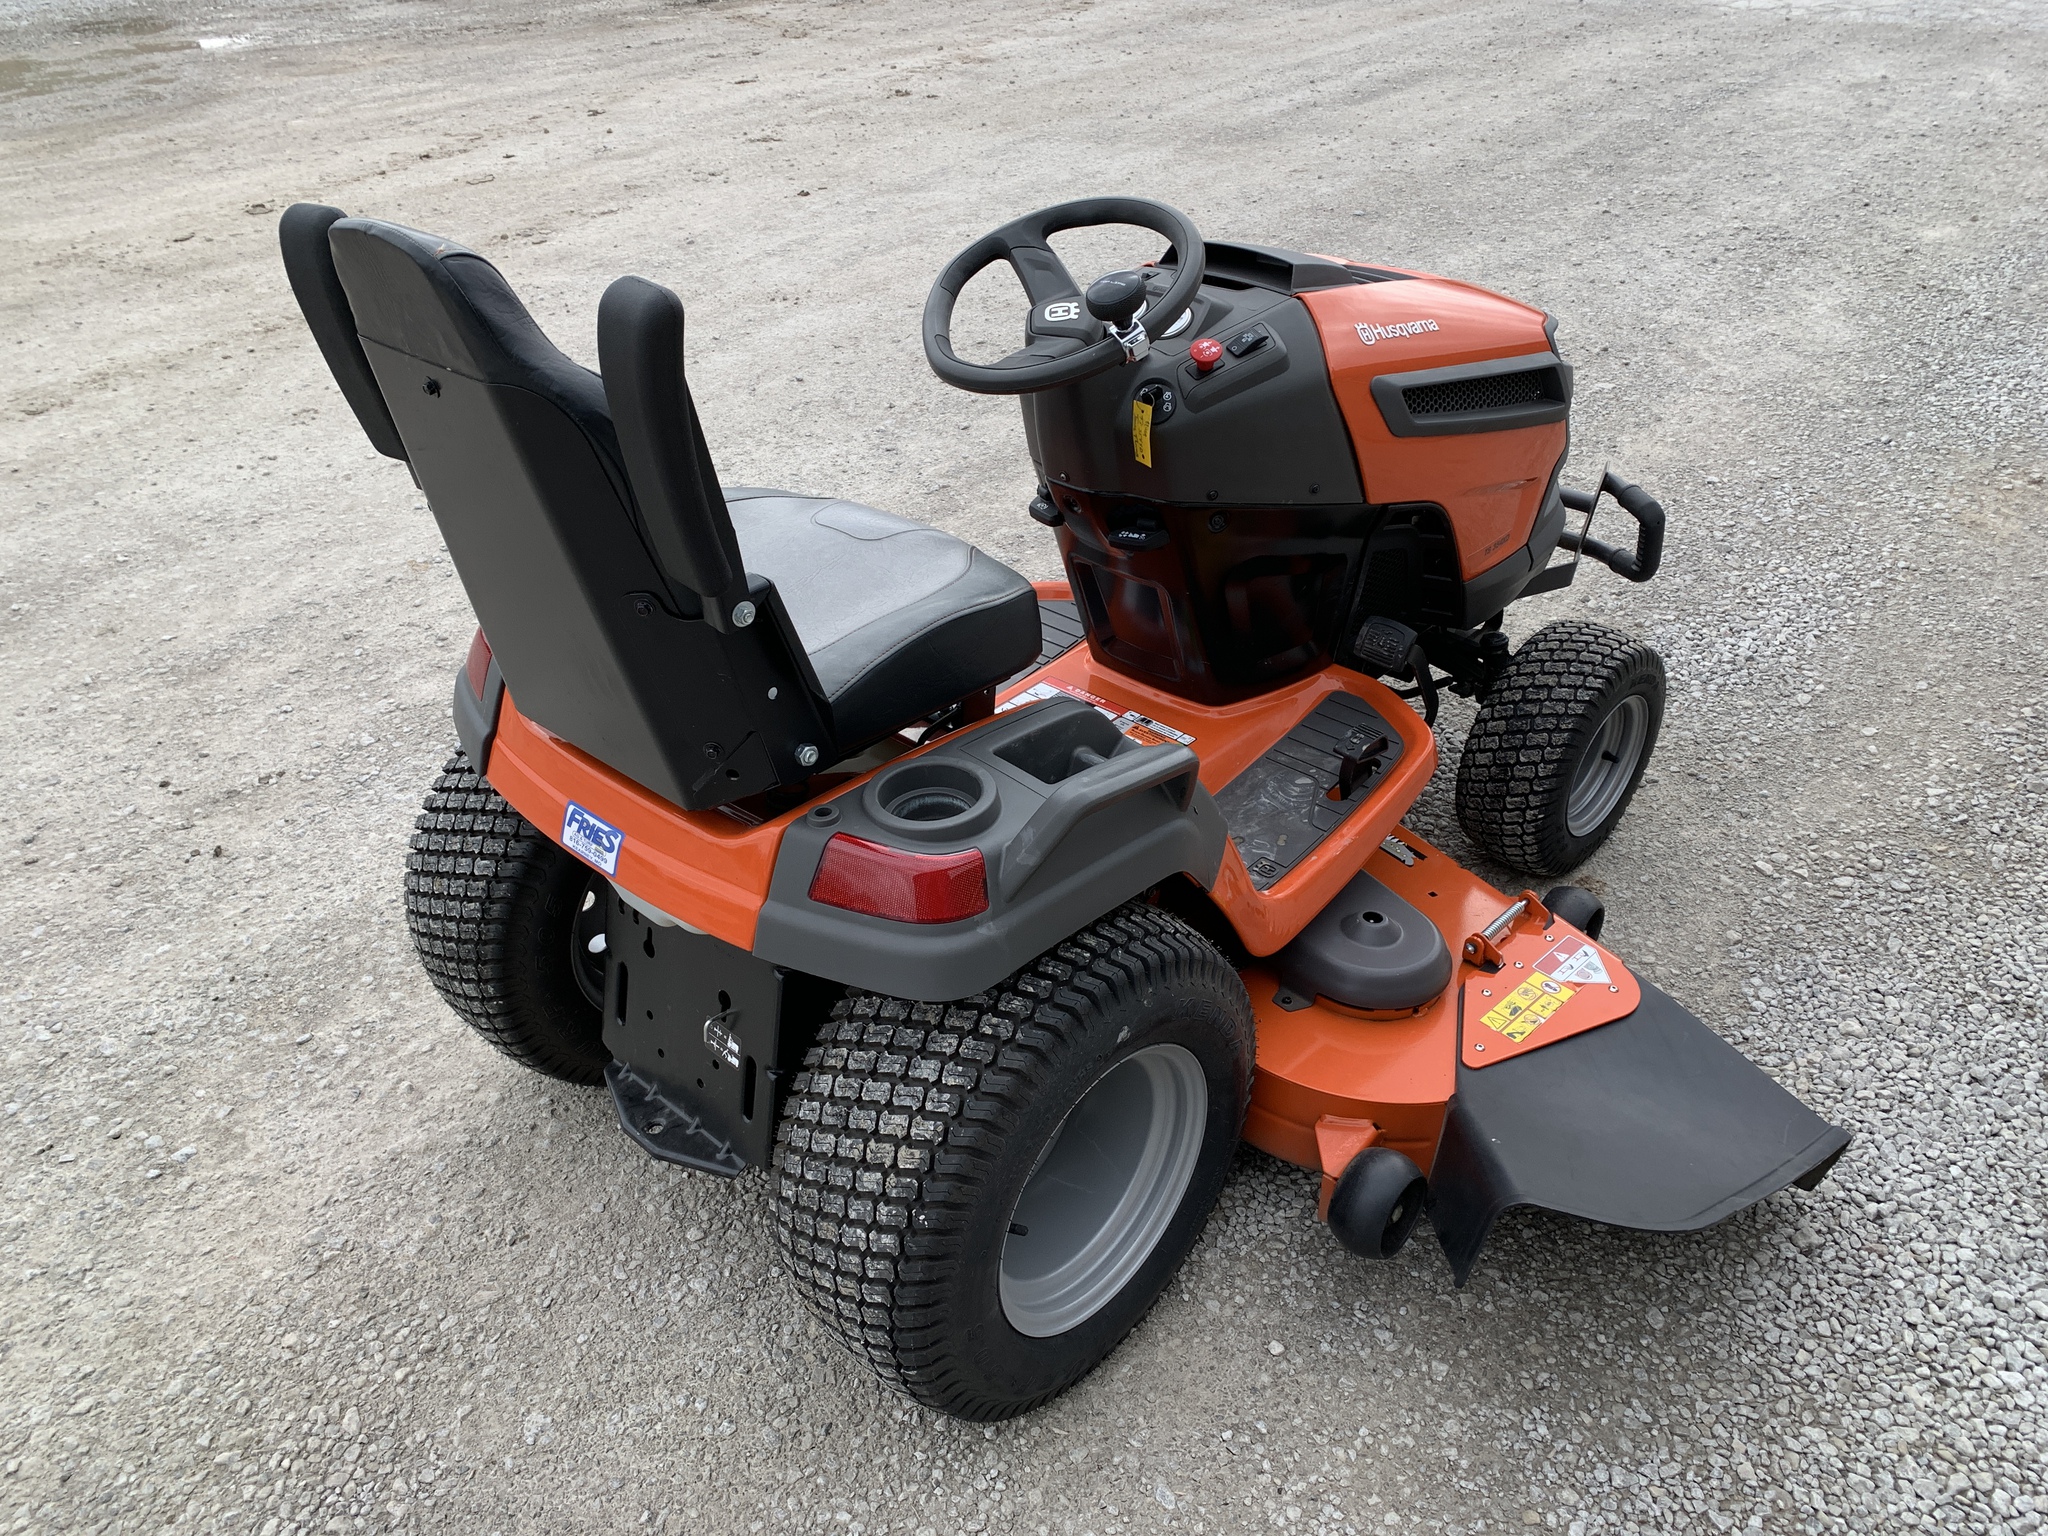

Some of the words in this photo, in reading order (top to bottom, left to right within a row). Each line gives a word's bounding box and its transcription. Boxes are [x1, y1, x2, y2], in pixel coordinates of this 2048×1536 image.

[1369, 318, 1440, 341] Husqvarna
[1074, 688, 1107, 705] DANGER
[567, 808, 619, 853] FRIES
[1174, 997, 1243, 1051] KENDA
